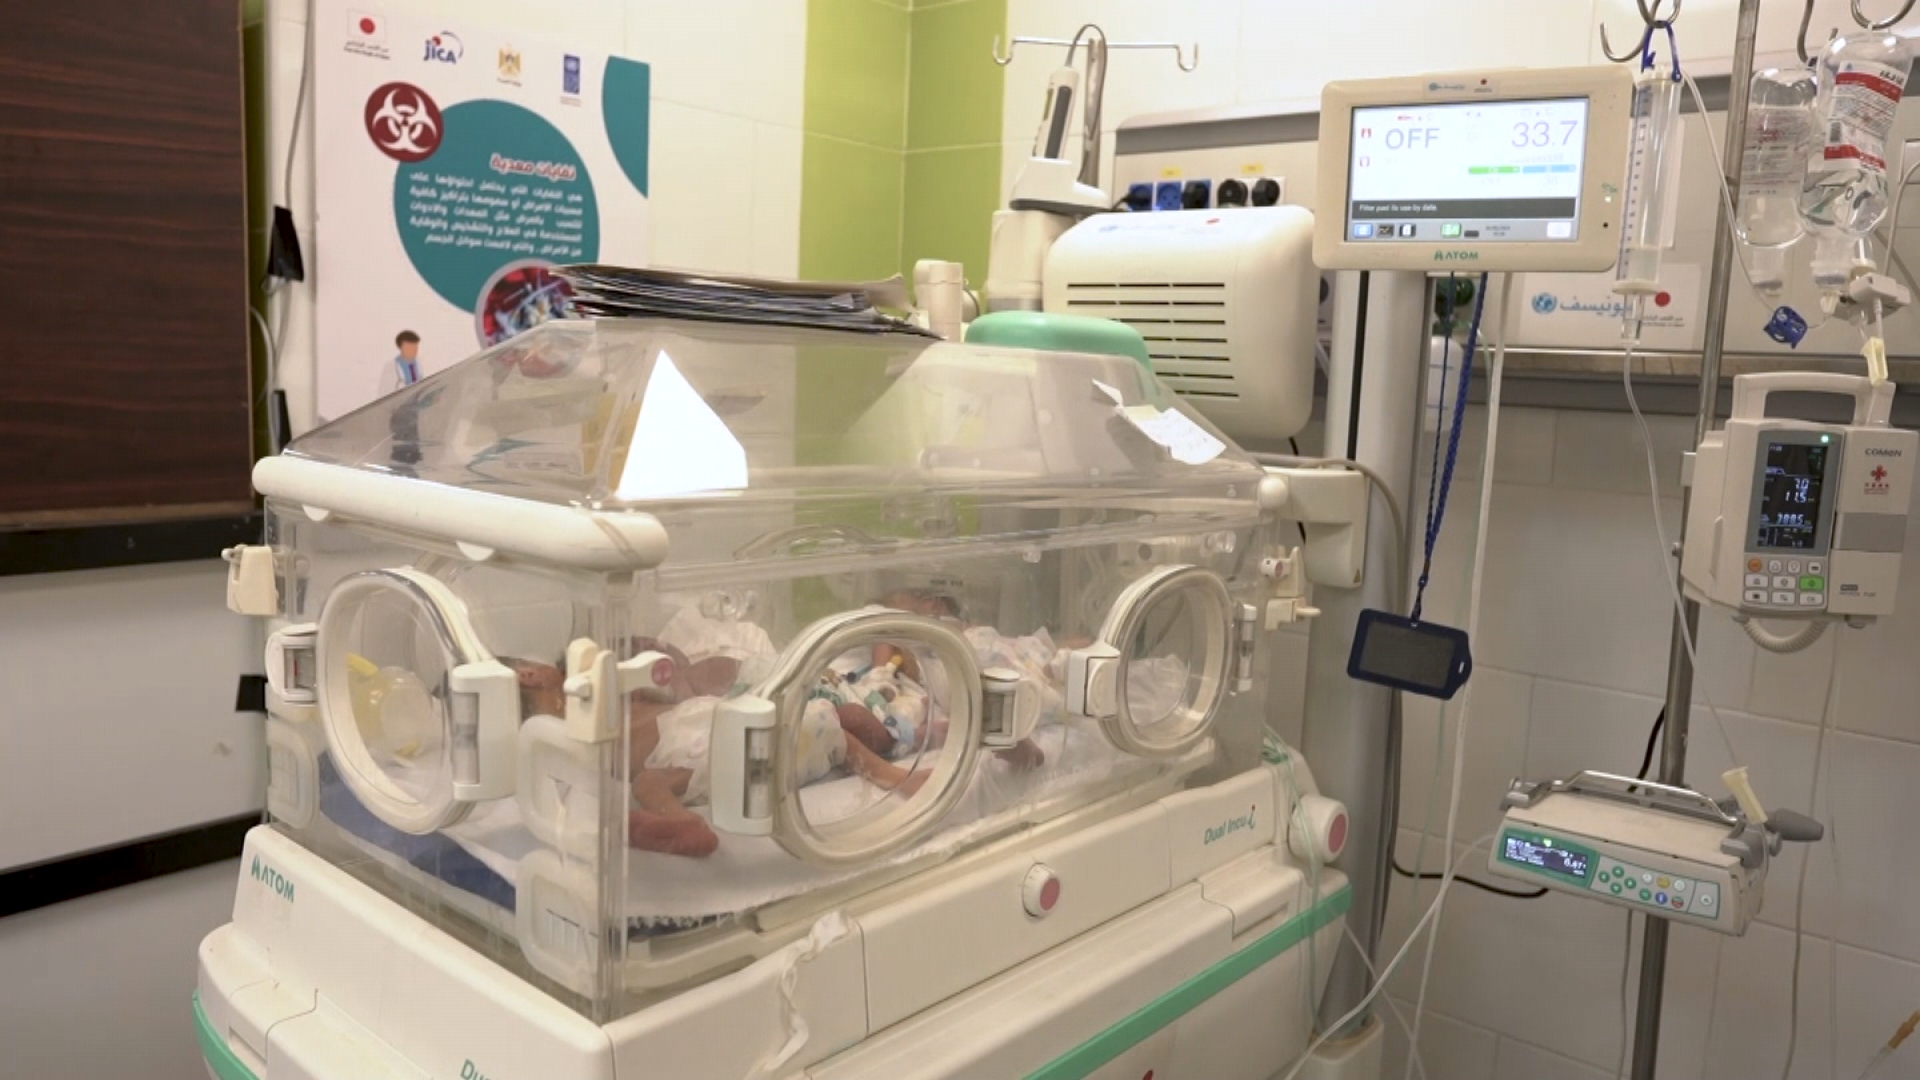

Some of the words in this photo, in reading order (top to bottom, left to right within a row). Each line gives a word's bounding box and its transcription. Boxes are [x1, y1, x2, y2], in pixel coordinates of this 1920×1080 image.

[1384, 127, 1440, 150] OFF
[1511, 119, 1579, 148] 33.7
[490, 153, 534, 174] معدية
[1204, 820, 1226, 845] Dual
